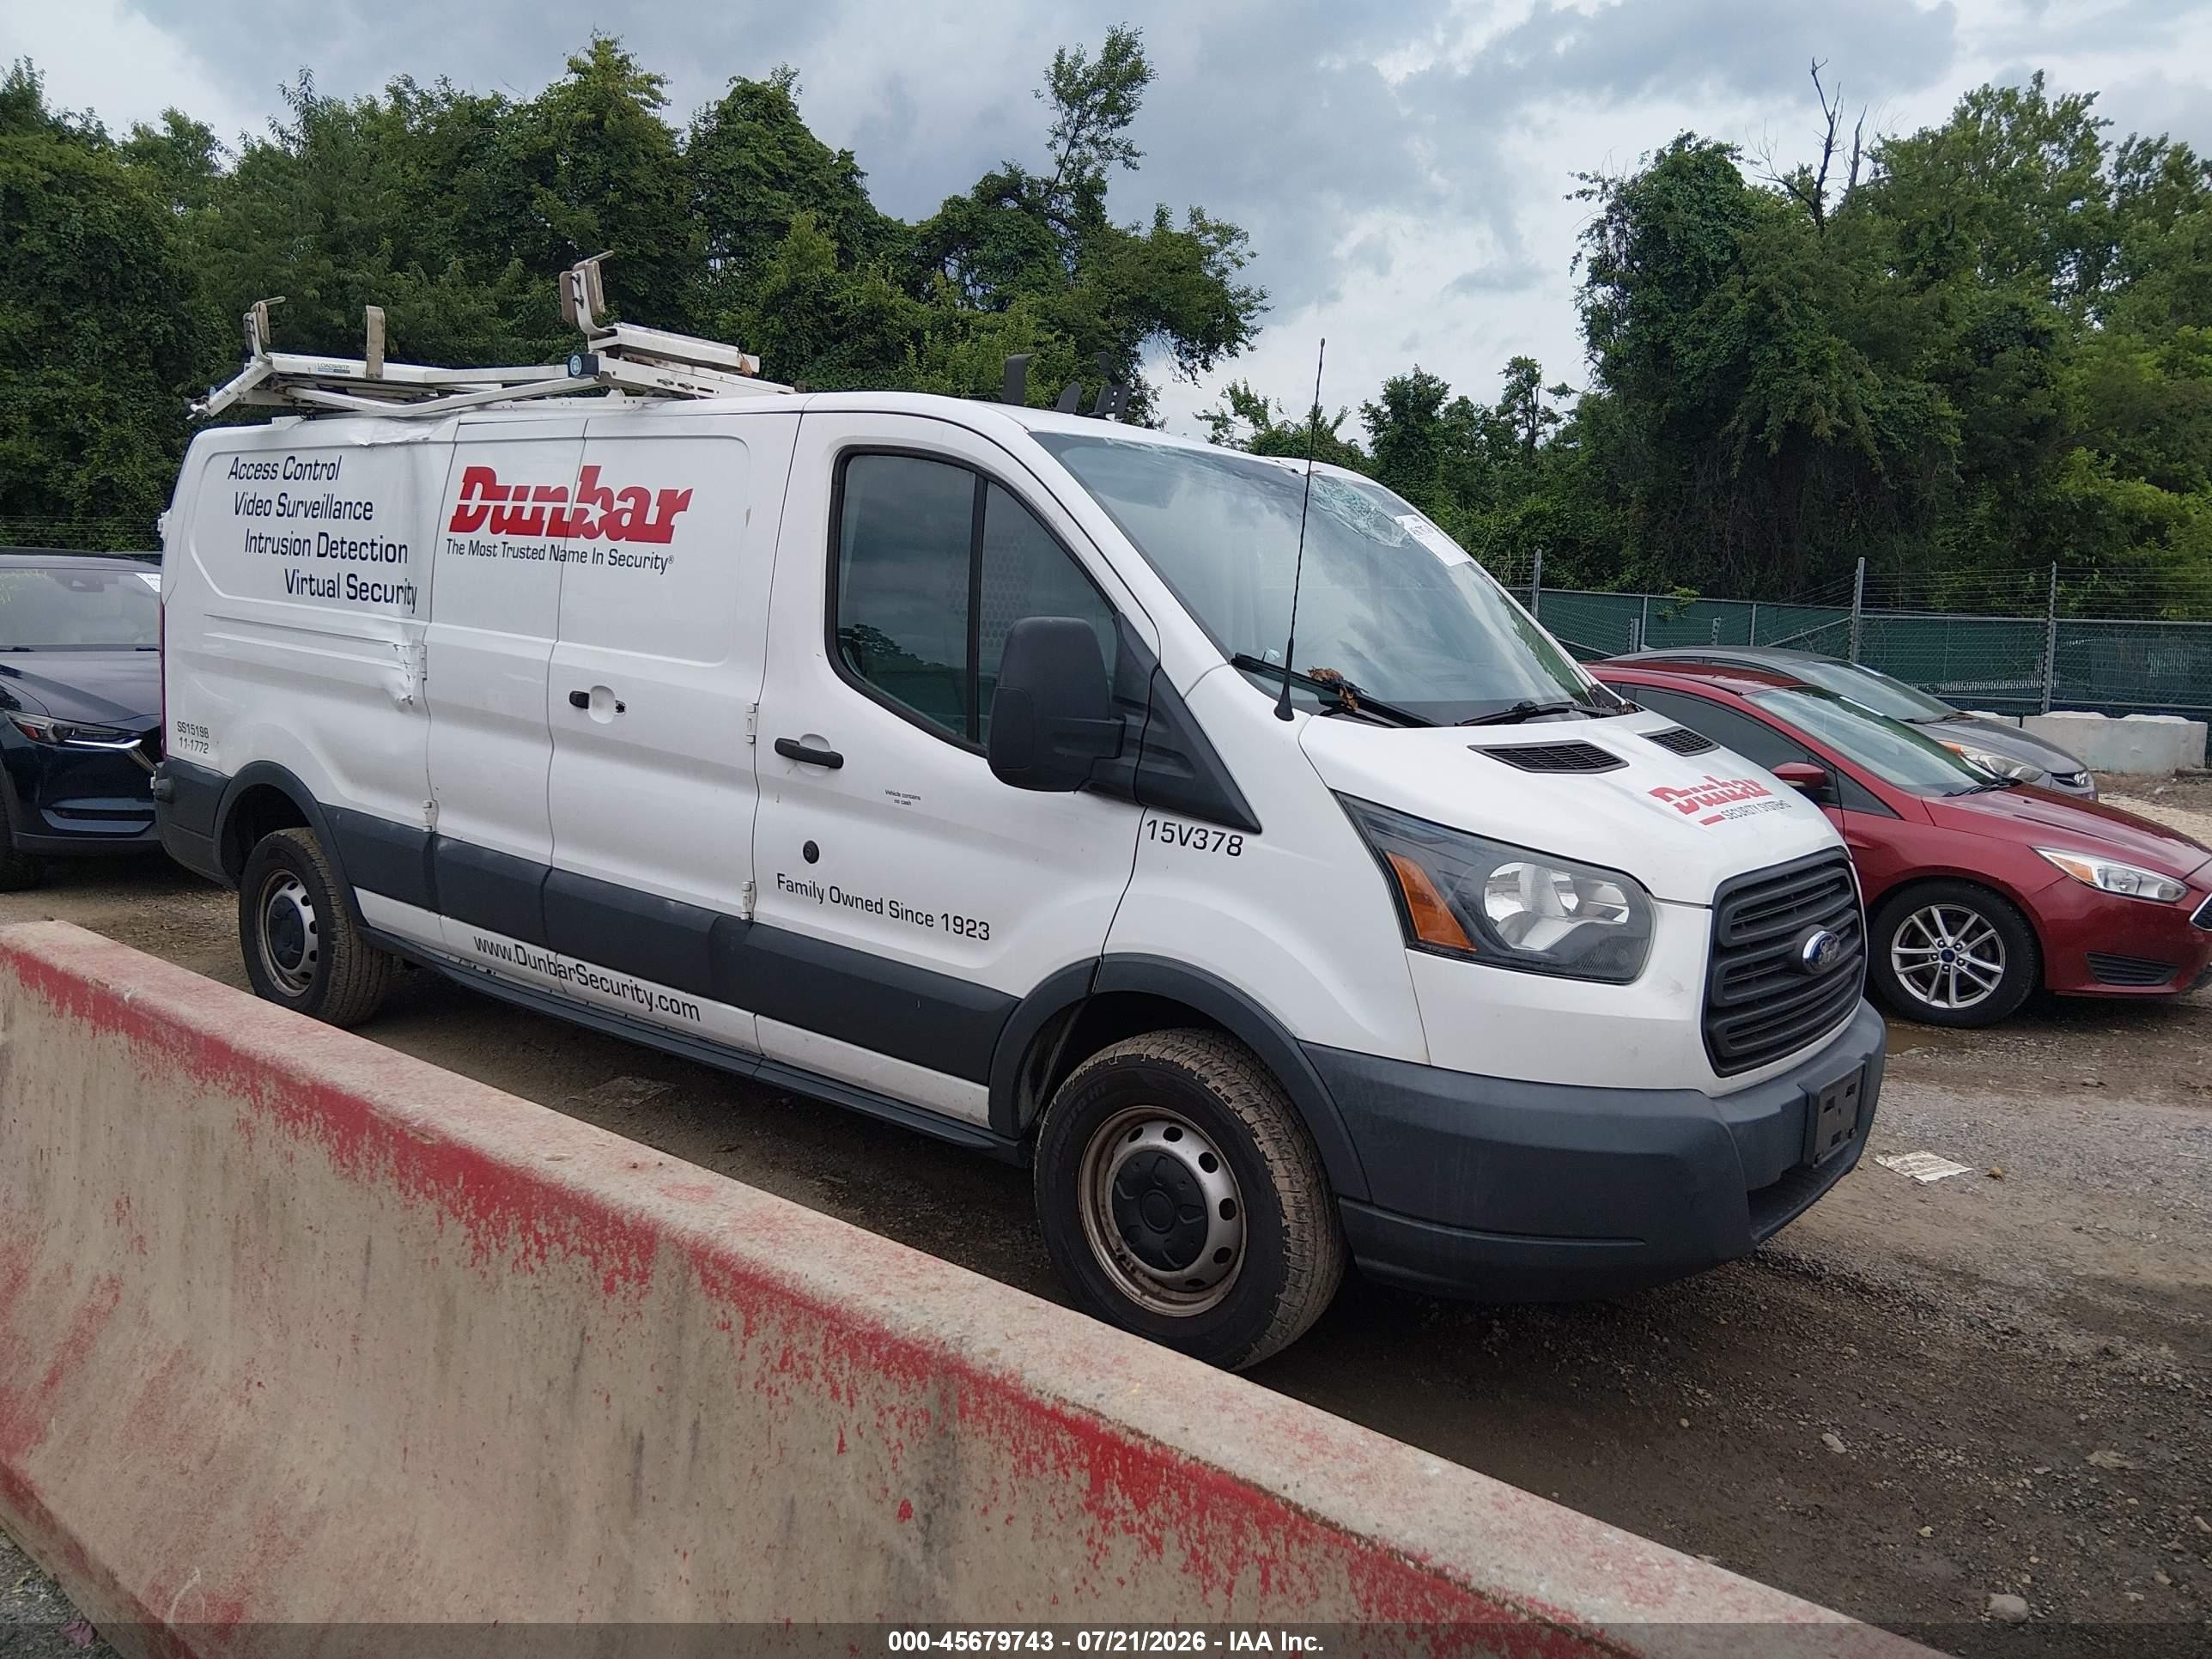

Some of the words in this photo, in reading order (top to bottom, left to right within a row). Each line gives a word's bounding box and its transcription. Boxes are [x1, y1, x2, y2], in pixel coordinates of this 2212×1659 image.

[228, 456, 279, 481] Access
[283, 455, 342, 481] Control
[234, 491, 272, 517] Video
[276, 492, 374, 521] Surveillance
[449, 465, 692, 544] Dunbar
[244, 528, 312, 556] Intrusion
[316, 531, 409, 564] Detection
[446, 538, 465, 556] The
[467, 539, 498, 559] Most
[501, 541, 546, 562] Trusted
[548, 544, 588, 565] Name
[591, 546, 603, 565] In
[284, 568, 341, 599] Virtual
[345, 573, 418, 615] Security
[179, 736, 210, 754] 11-1772
[1648, 775, 1772, 815] Dunbar
[1721, 803, 1760, 820] SECURITY
[1758, 800, 1791, 812] SYSTEMS
[1146, 819, 1243, 856] 15V378
[776, 872, 824, 904] Family
[829, 886, 884, 915] Owned
[888, 900, 934, 927] Since
[939, 913, 990, 941] 1923
[473, 935, 701, 1023] www.DunbarSecurity.com
